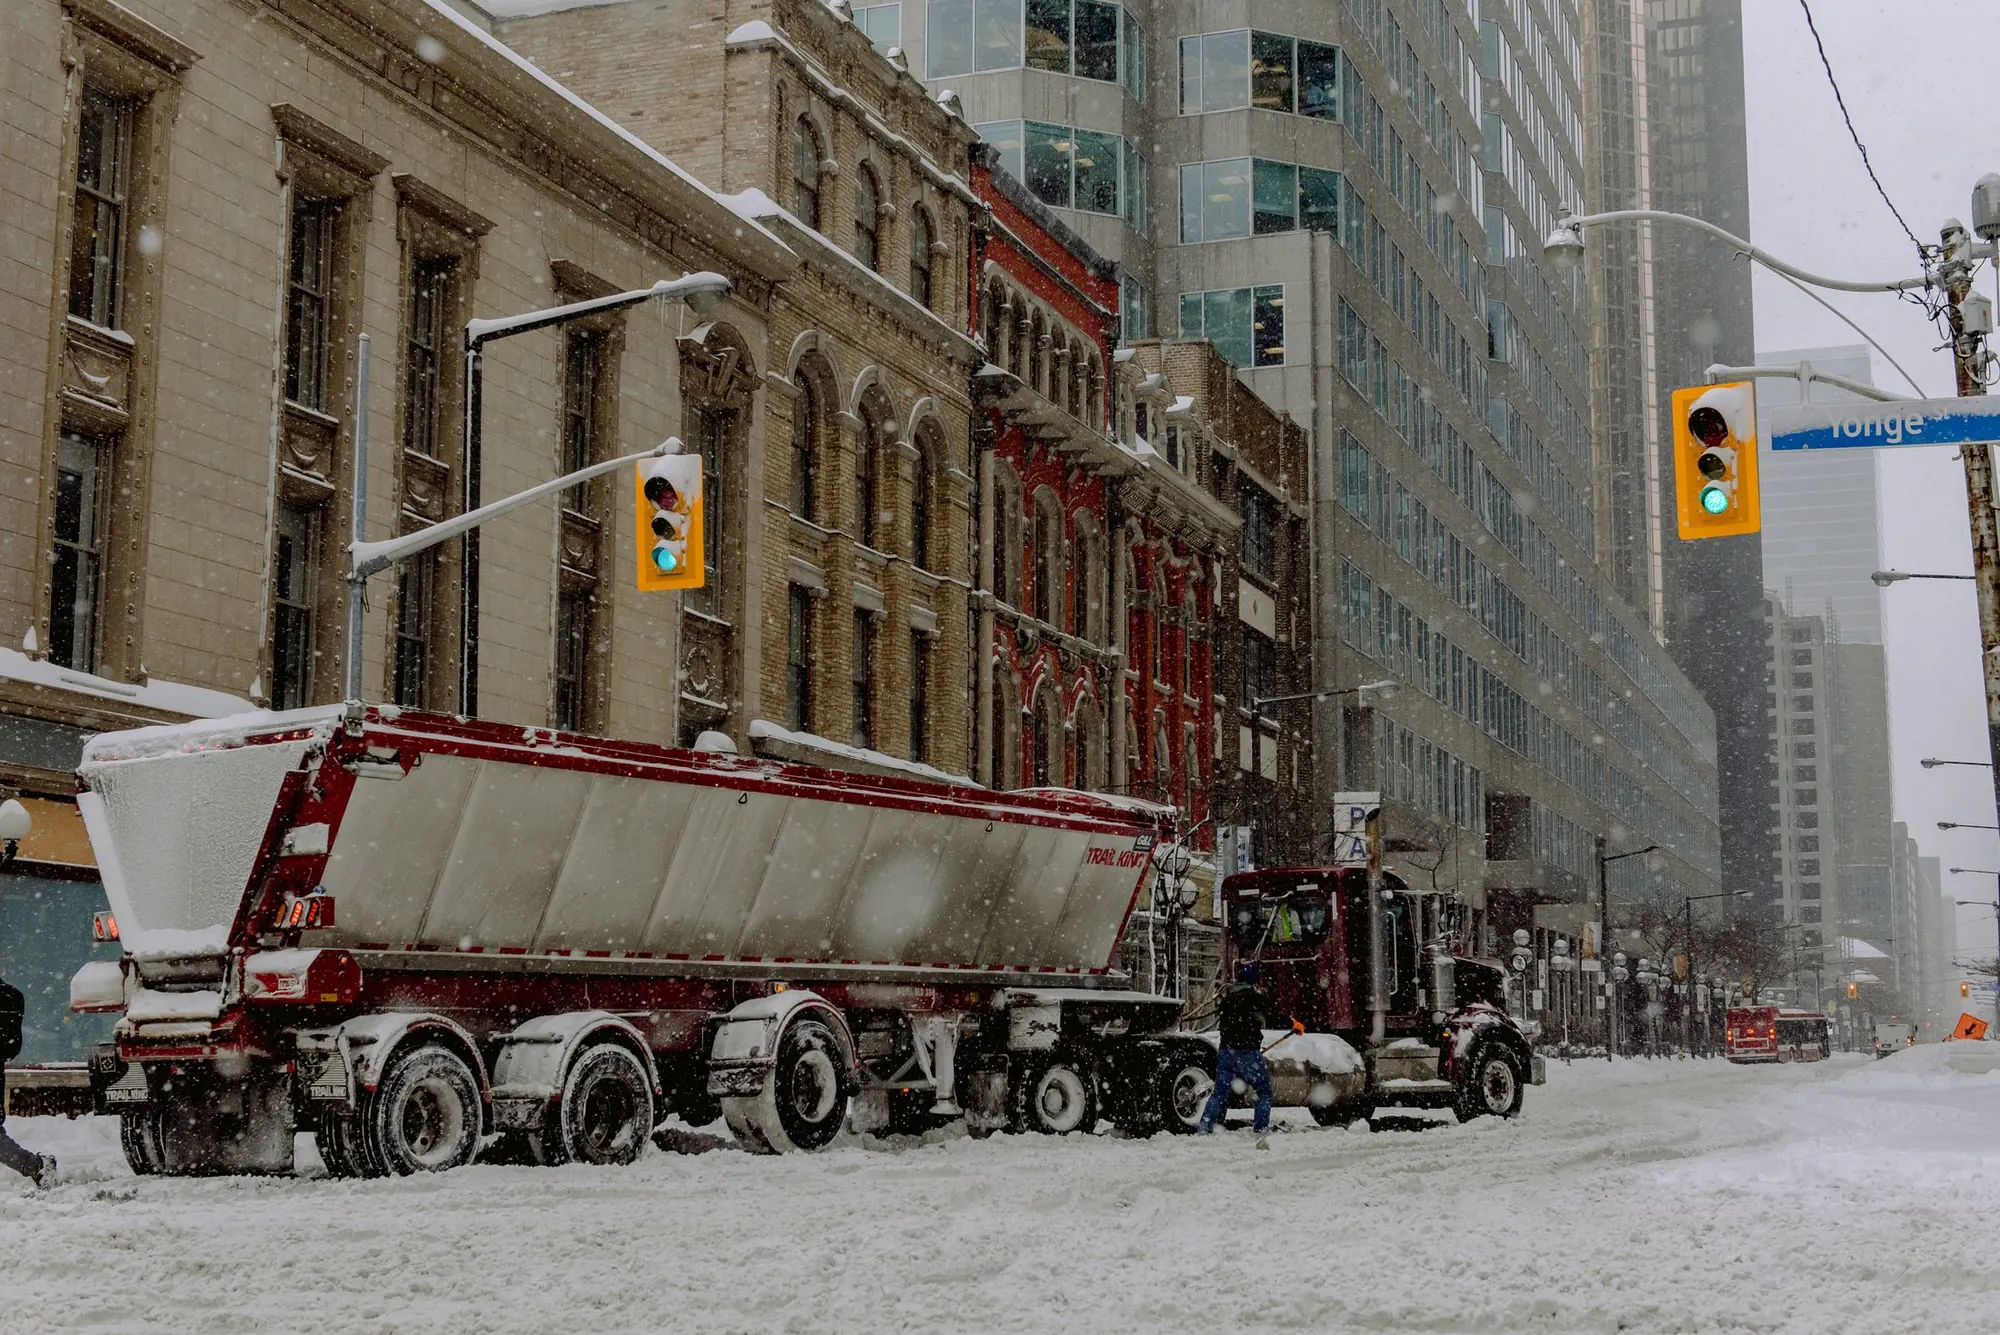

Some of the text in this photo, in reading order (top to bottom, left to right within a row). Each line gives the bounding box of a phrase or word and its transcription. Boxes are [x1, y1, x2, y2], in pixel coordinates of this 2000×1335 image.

[1827, 408, 1924, 444] Yonge
[1086, 846, 1145, 869] TRAIL KING
[105, 1089, 131, 1101] TRAIL
